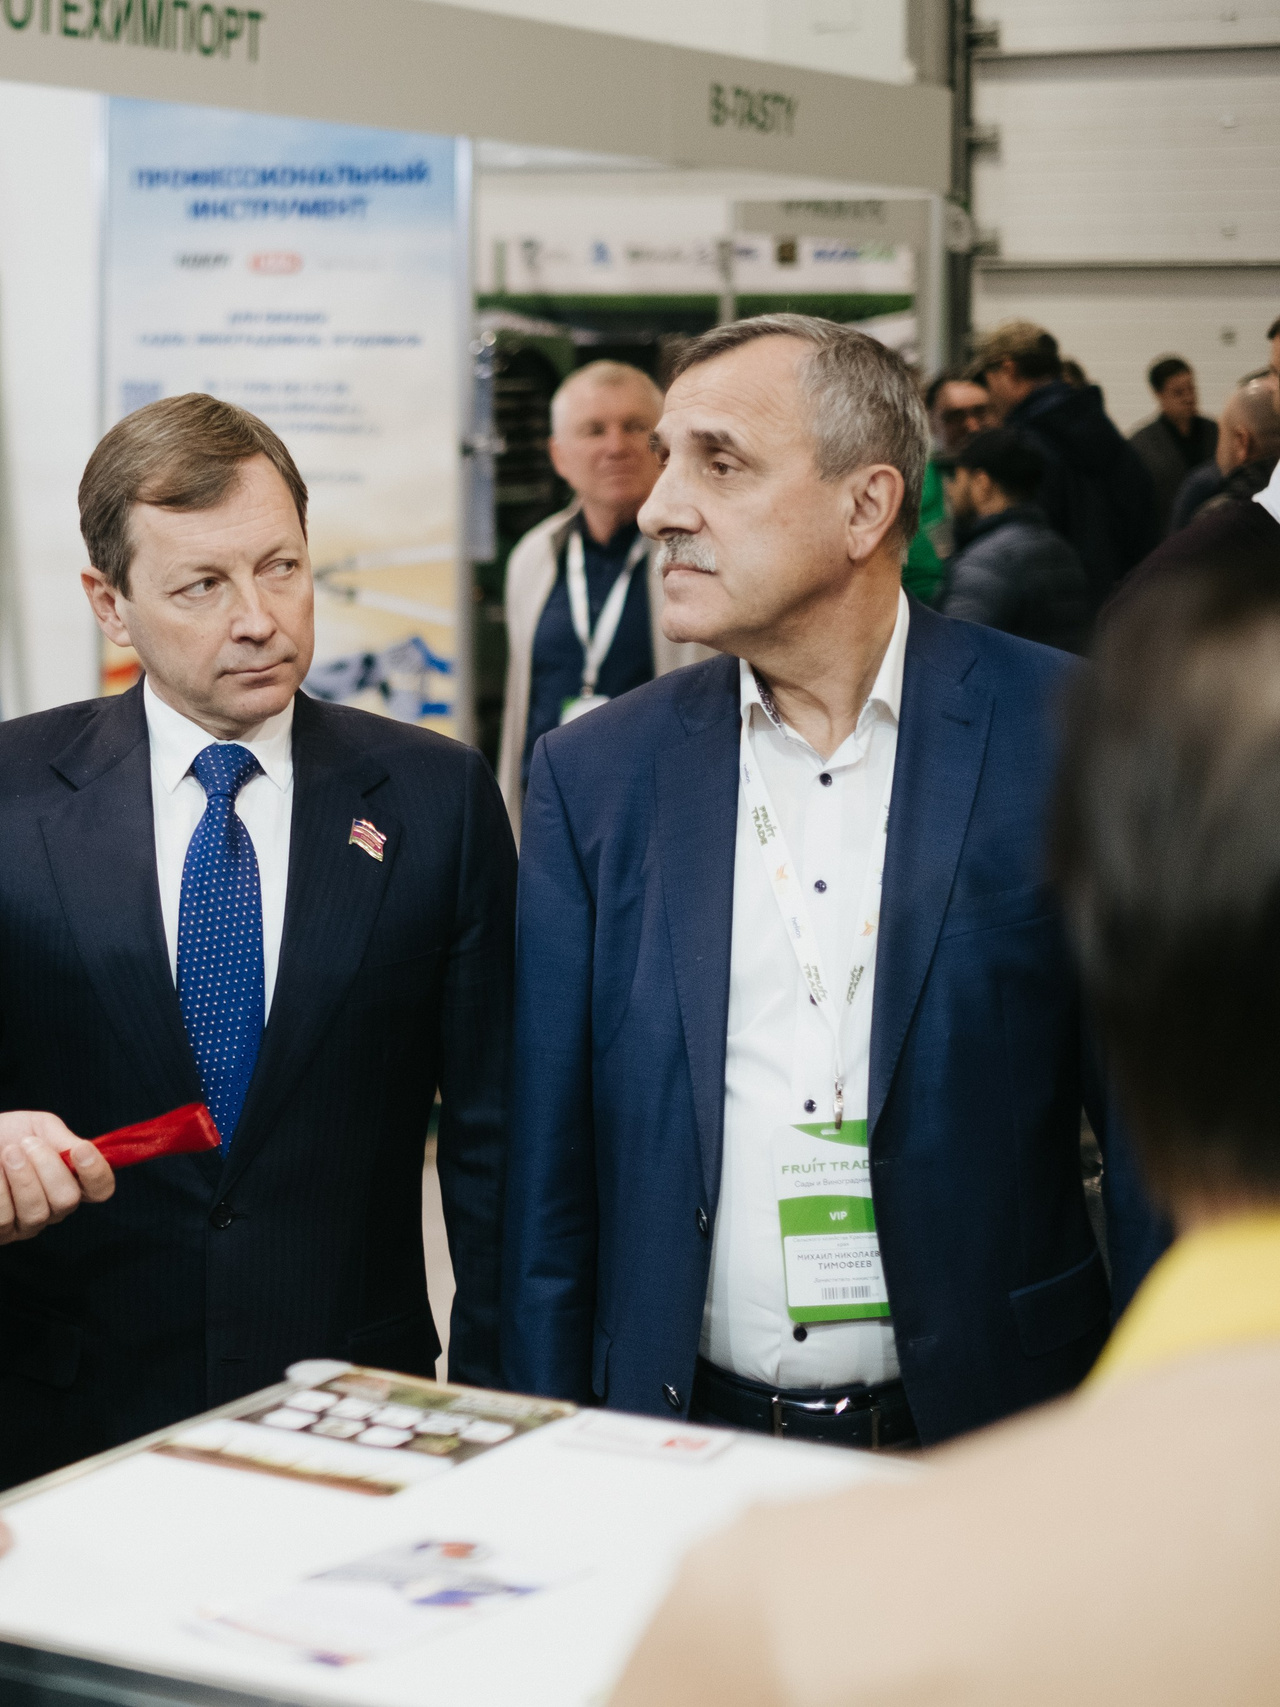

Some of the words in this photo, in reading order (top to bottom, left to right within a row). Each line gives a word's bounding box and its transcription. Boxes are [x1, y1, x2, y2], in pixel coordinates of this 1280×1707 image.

[708, 82, 799, 138] B-TASTY
[135, 158, 430, 189] ПРОФЕССИОНАЛЬНЫЙ
[188, 195, 370, 220] ИНСТРУМЕНТ
[751, 806, 768, 846] TRADE
[803, 963, 822, 1002] TRADE
[829, 1160, 870, 1171] TRAD
[829, 1211, 848, 1221] VIP
[797, 1253, 833, 1261] МИХАИЛ
[835, 1250, 880, 1259] НИКОЛАЕВ
[818, 1260, 872, 1270] ТИМОФЕЕВ
